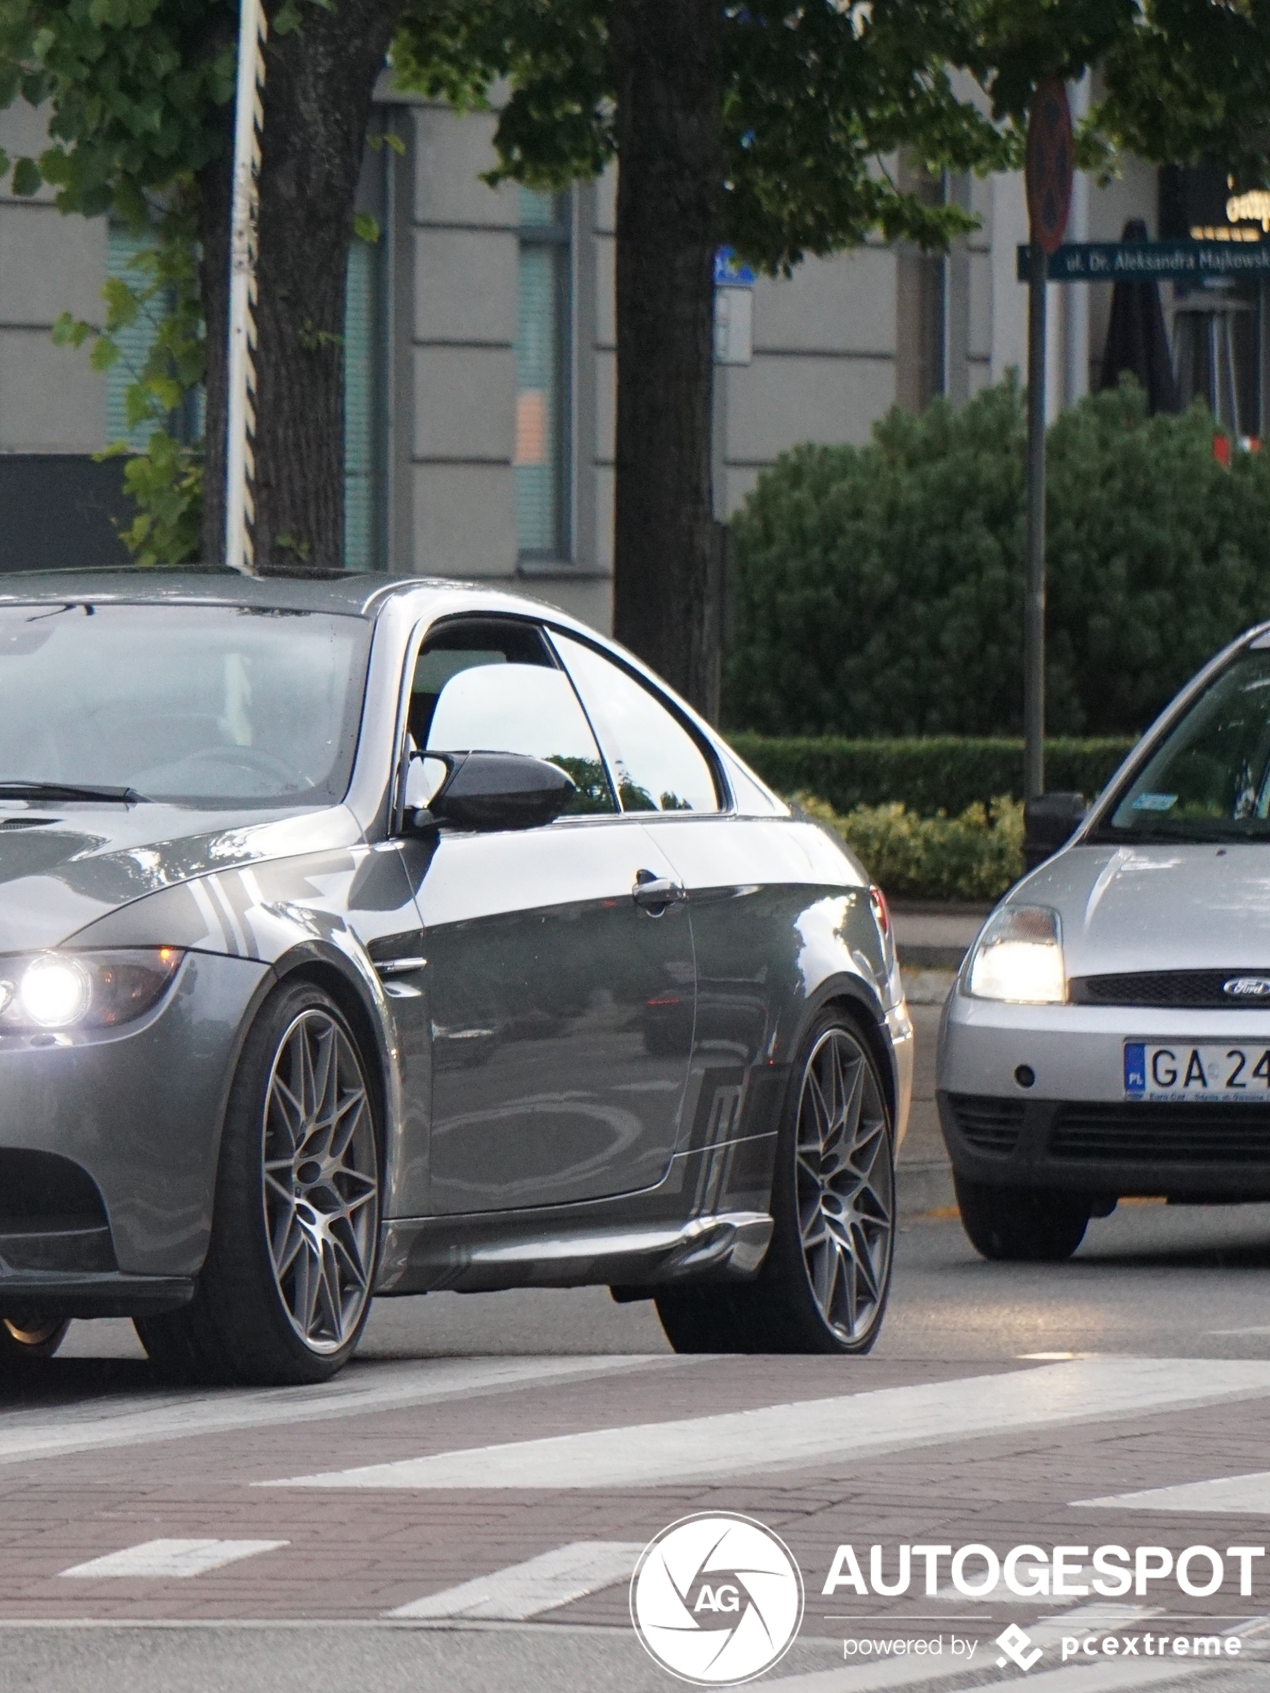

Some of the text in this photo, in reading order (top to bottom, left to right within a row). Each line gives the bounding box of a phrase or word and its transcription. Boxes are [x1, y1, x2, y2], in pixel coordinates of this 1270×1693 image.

[1089, 251, 1110, 271] Dr.
[1114, 249, 1195, 271] Aleksandra
[1233, 979, 1264, 995] Ford
[1152, 1049, 1207, 1088] GA
[1128, 1072, 1143, 1086] PL
